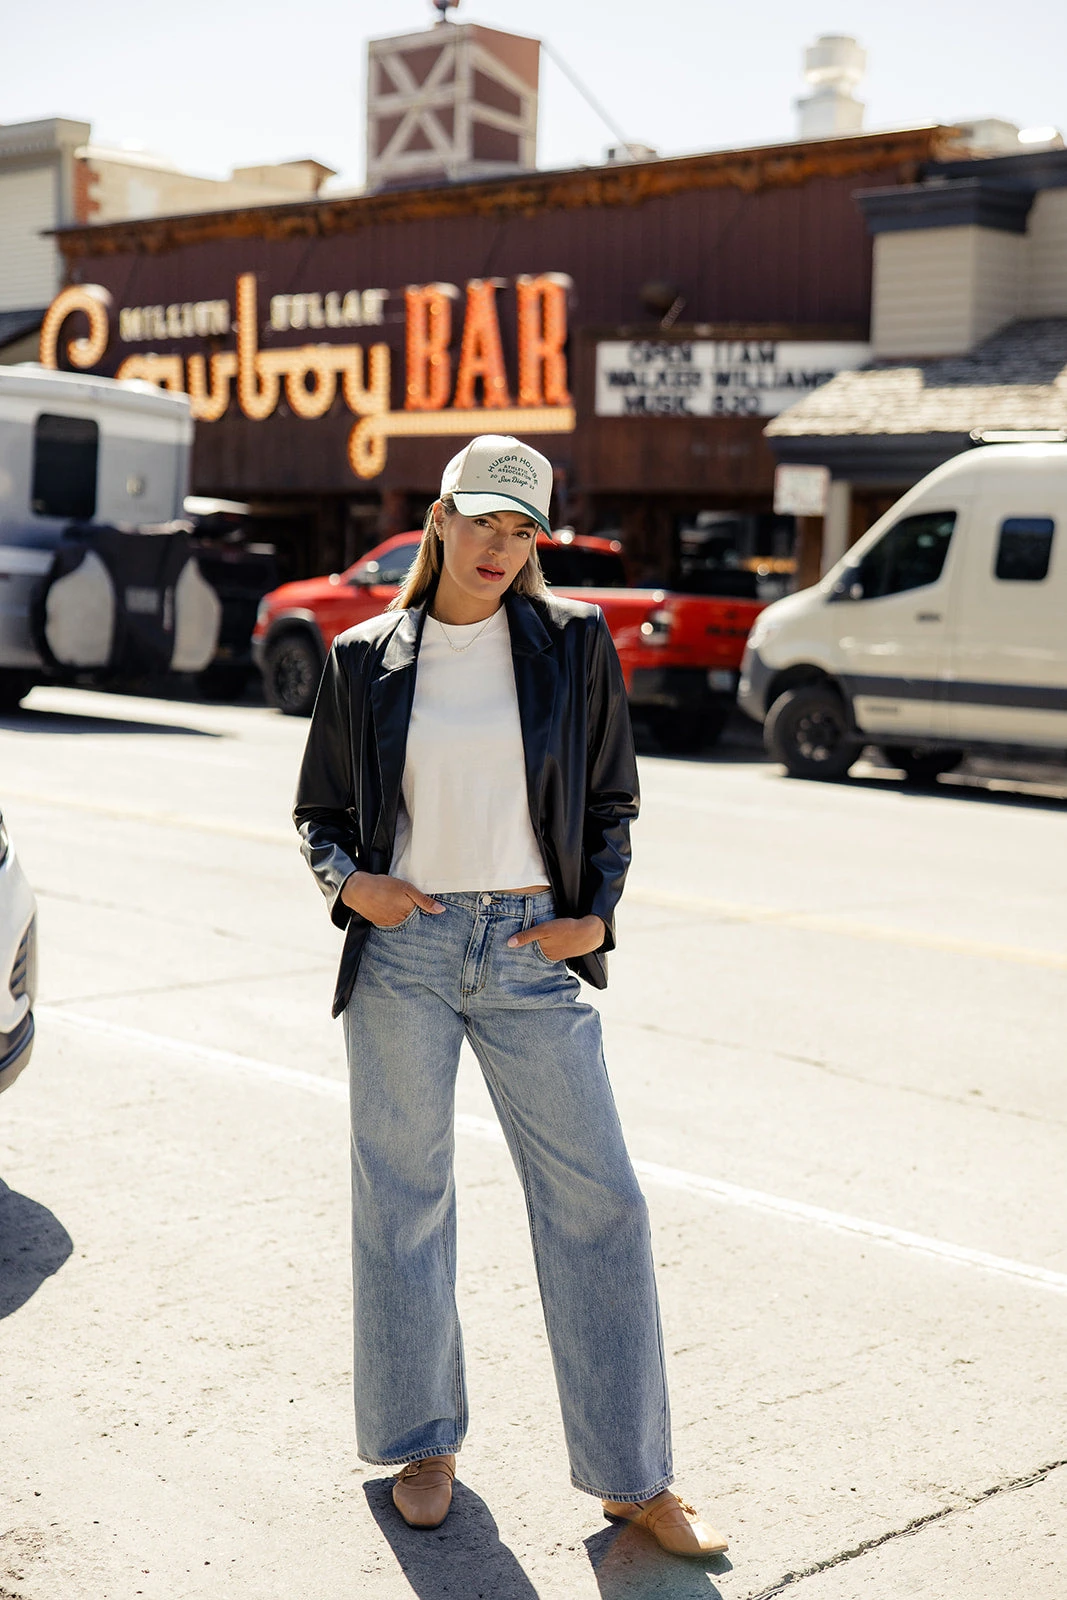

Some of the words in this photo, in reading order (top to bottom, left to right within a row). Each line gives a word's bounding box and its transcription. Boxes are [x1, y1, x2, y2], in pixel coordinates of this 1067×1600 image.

[405, 271, 573, 411] BAR
[628, 341, 693, 363] OPEN
[487, 455, 518, 472] HUEGA
[519, 457, 538, 485] HOUSE
[498, 475, 511, 483] San
[511, 476, 528, 487] Diego
